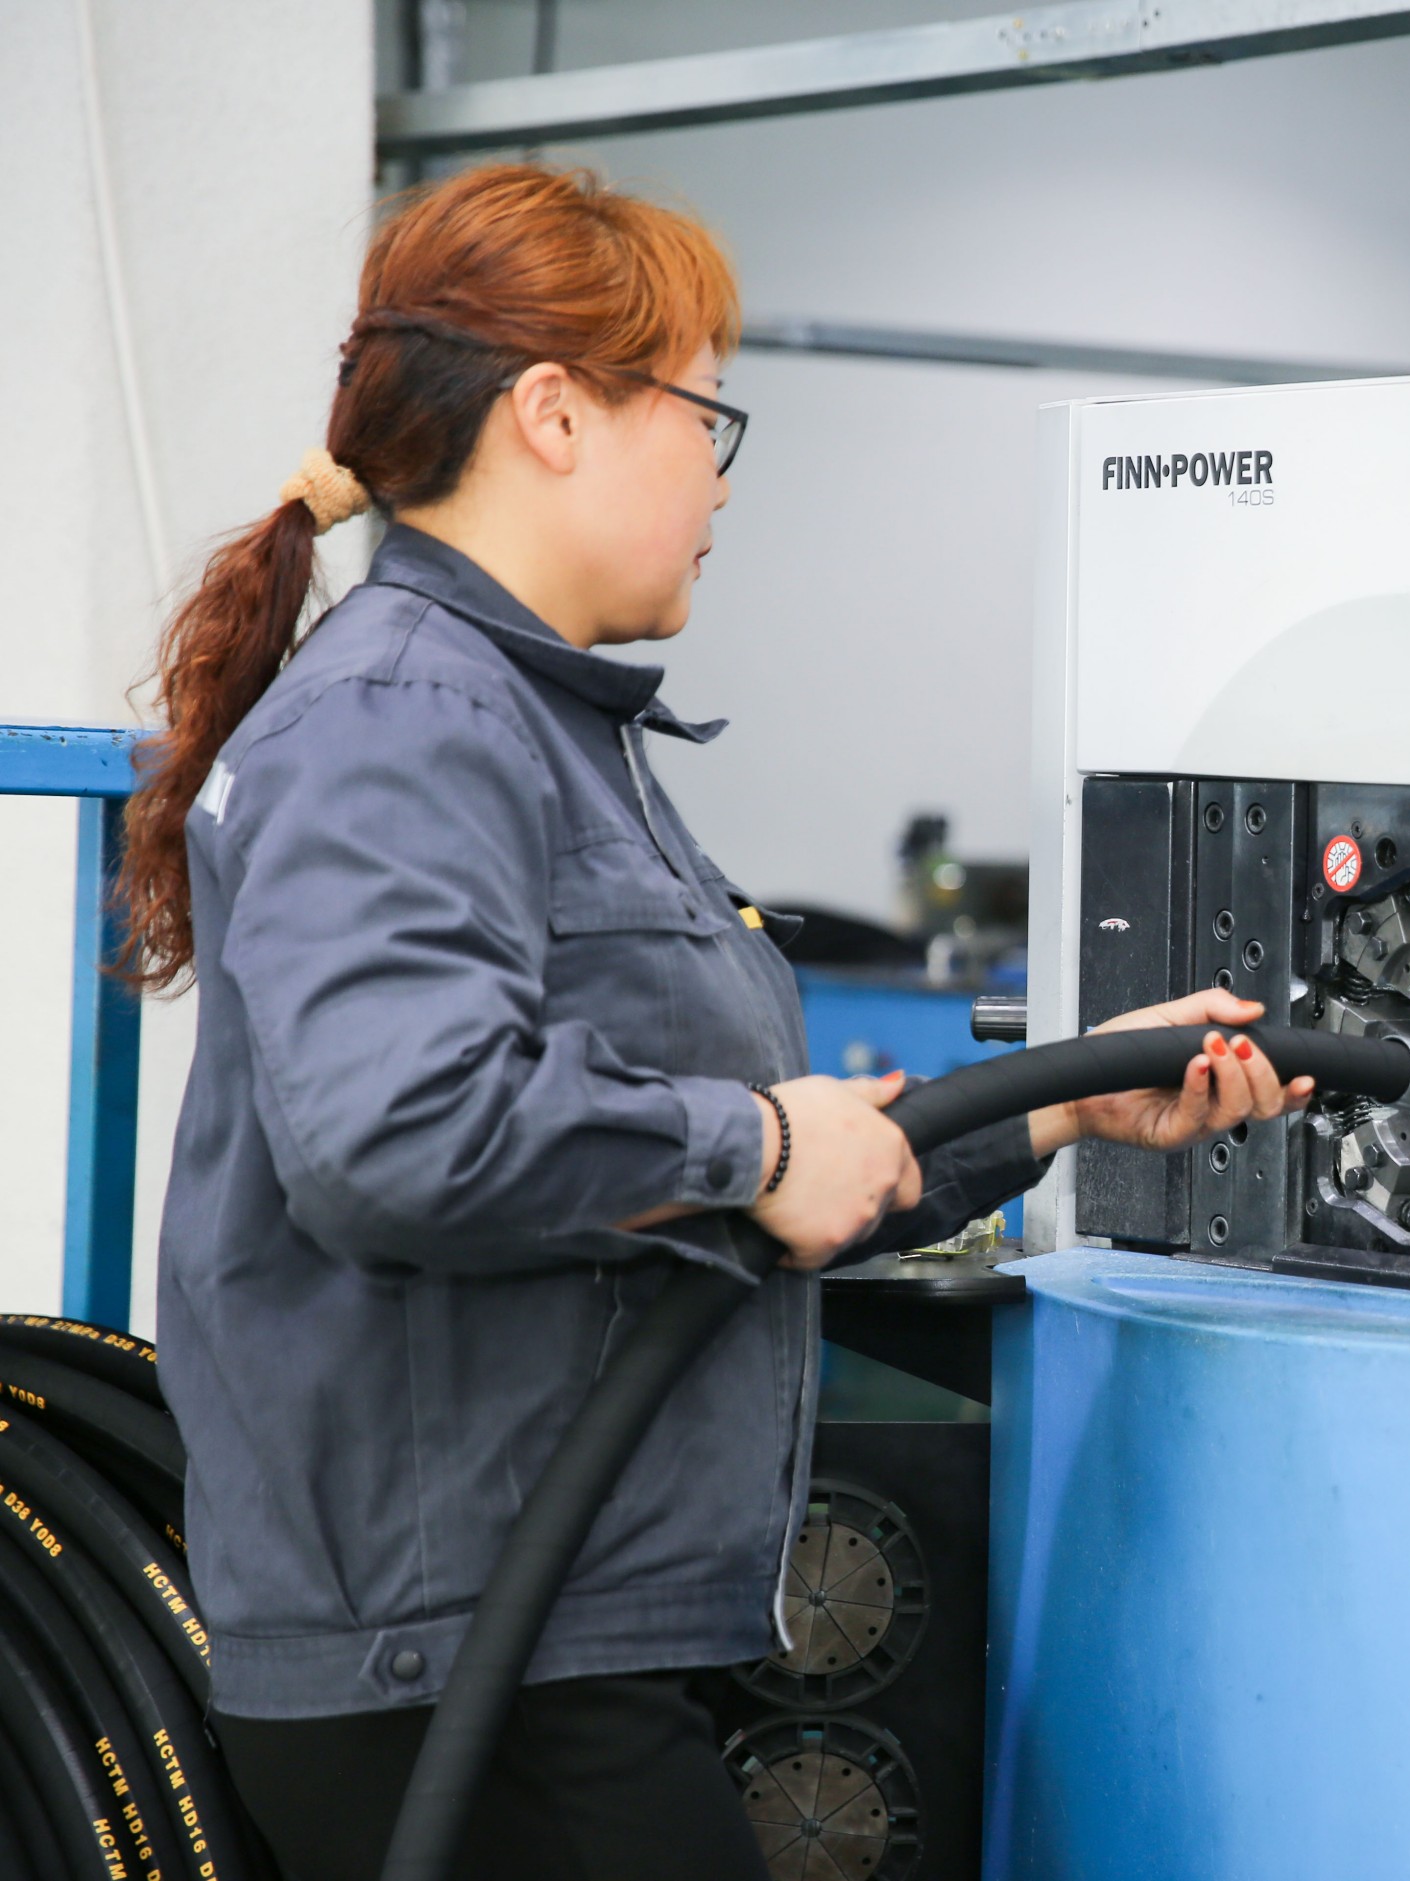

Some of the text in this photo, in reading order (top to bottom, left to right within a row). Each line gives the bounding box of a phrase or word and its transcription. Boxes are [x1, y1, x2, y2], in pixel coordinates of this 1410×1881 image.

[1228, 489, 1274, 507] 140S
[4, 1492, 32, 1521] D38
[143, 1562, 188, 1615] HCTM
[95, 1736, 129, 1797] HCTM
[122, 1802, 153, 1860] HD16
[153, 1728, 218, 1881] HCTM HD16 D
[93, 1817, 128, 1881] HCTM
